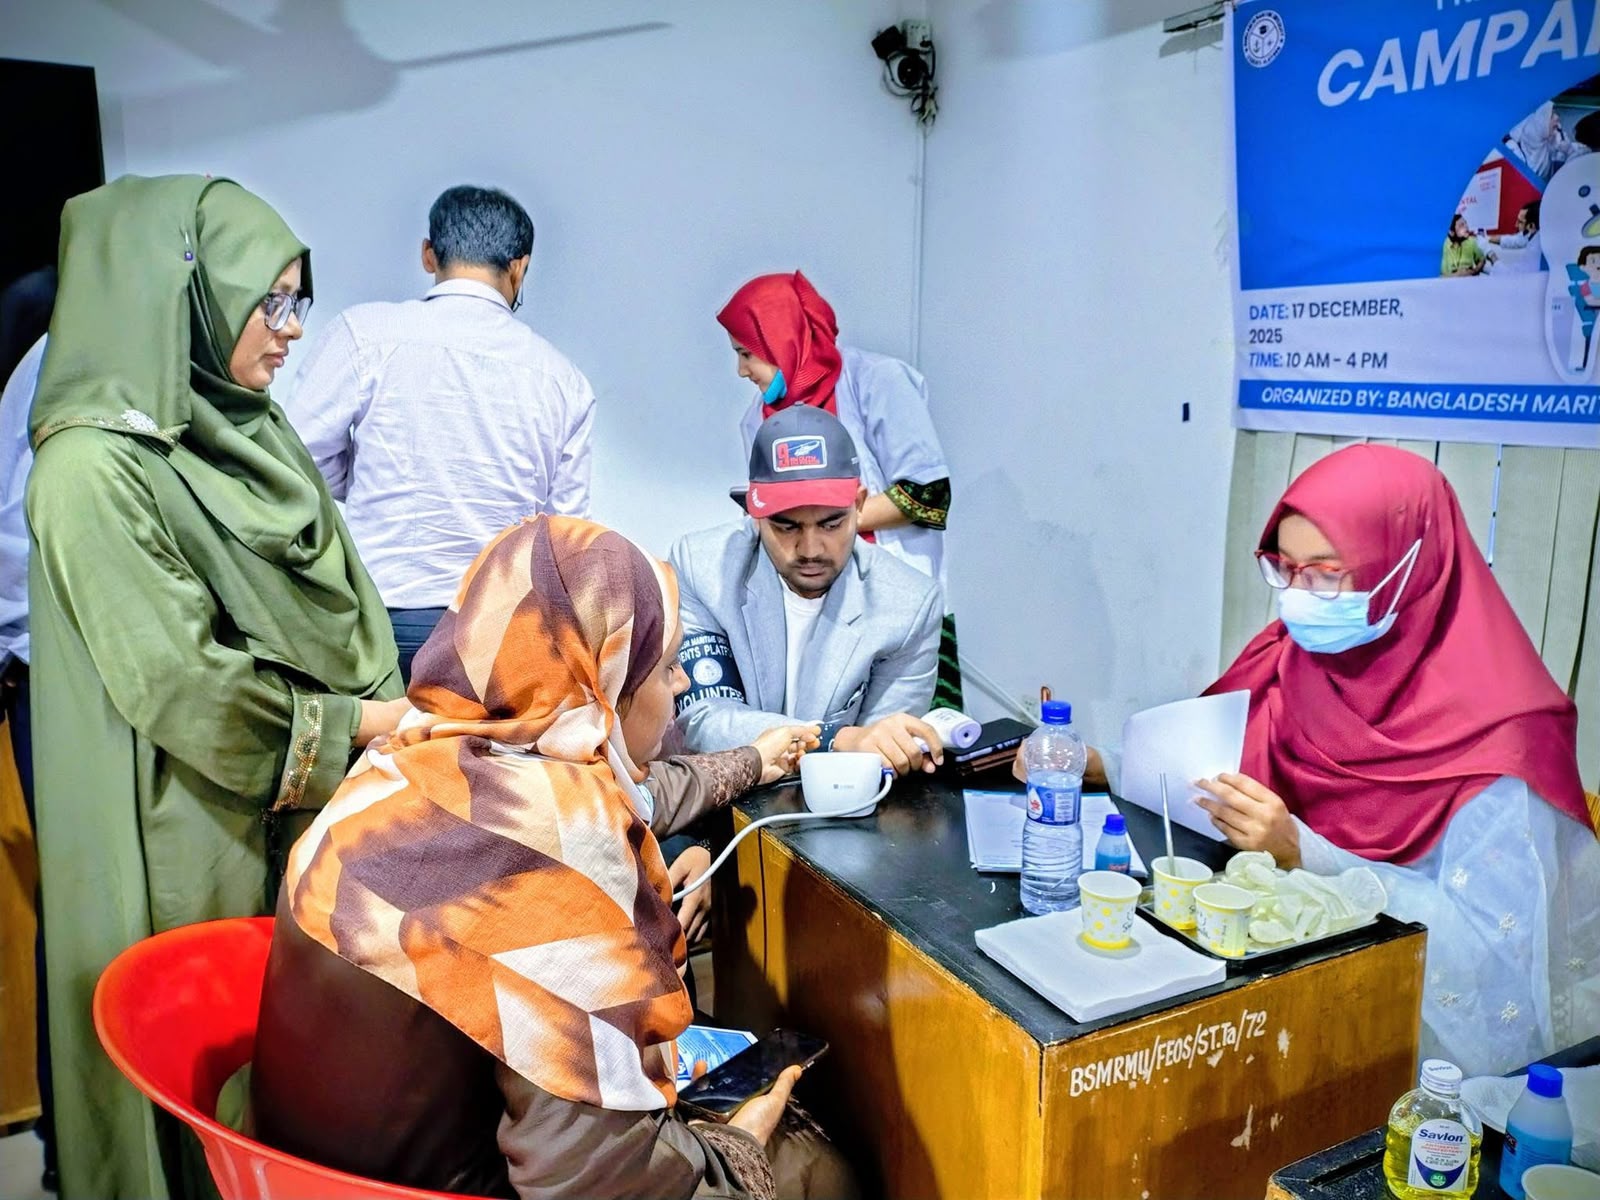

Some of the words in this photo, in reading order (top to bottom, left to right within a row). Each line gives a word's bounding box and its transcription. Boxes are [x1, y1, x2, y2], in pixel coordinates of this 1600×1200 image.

[1249, 304, 1289, 320] DATE:
[1292, 303, 1305, 319] 17
[1309, 298, 1403, 318] DECEMBER,
[1249, 328, 1283, 344] 2025
[1249, 352, 1283, 368] TIME:
[1286, 352, 1301, 368] 10
[1304, 352, 1331, 368] AM
[1346, 353, 1357, 368] 4
[1360, 352, 1388, 369] PM
[1261, 386, 1352, 407] ORGANIZED
[1356, 389, 1384, 408] BY:
[1386, 391, 1528, 413] BANGLADESH
[679, 646, 702, 663] ENTS
[1418, 1128, 1464, 1142] Savlon
